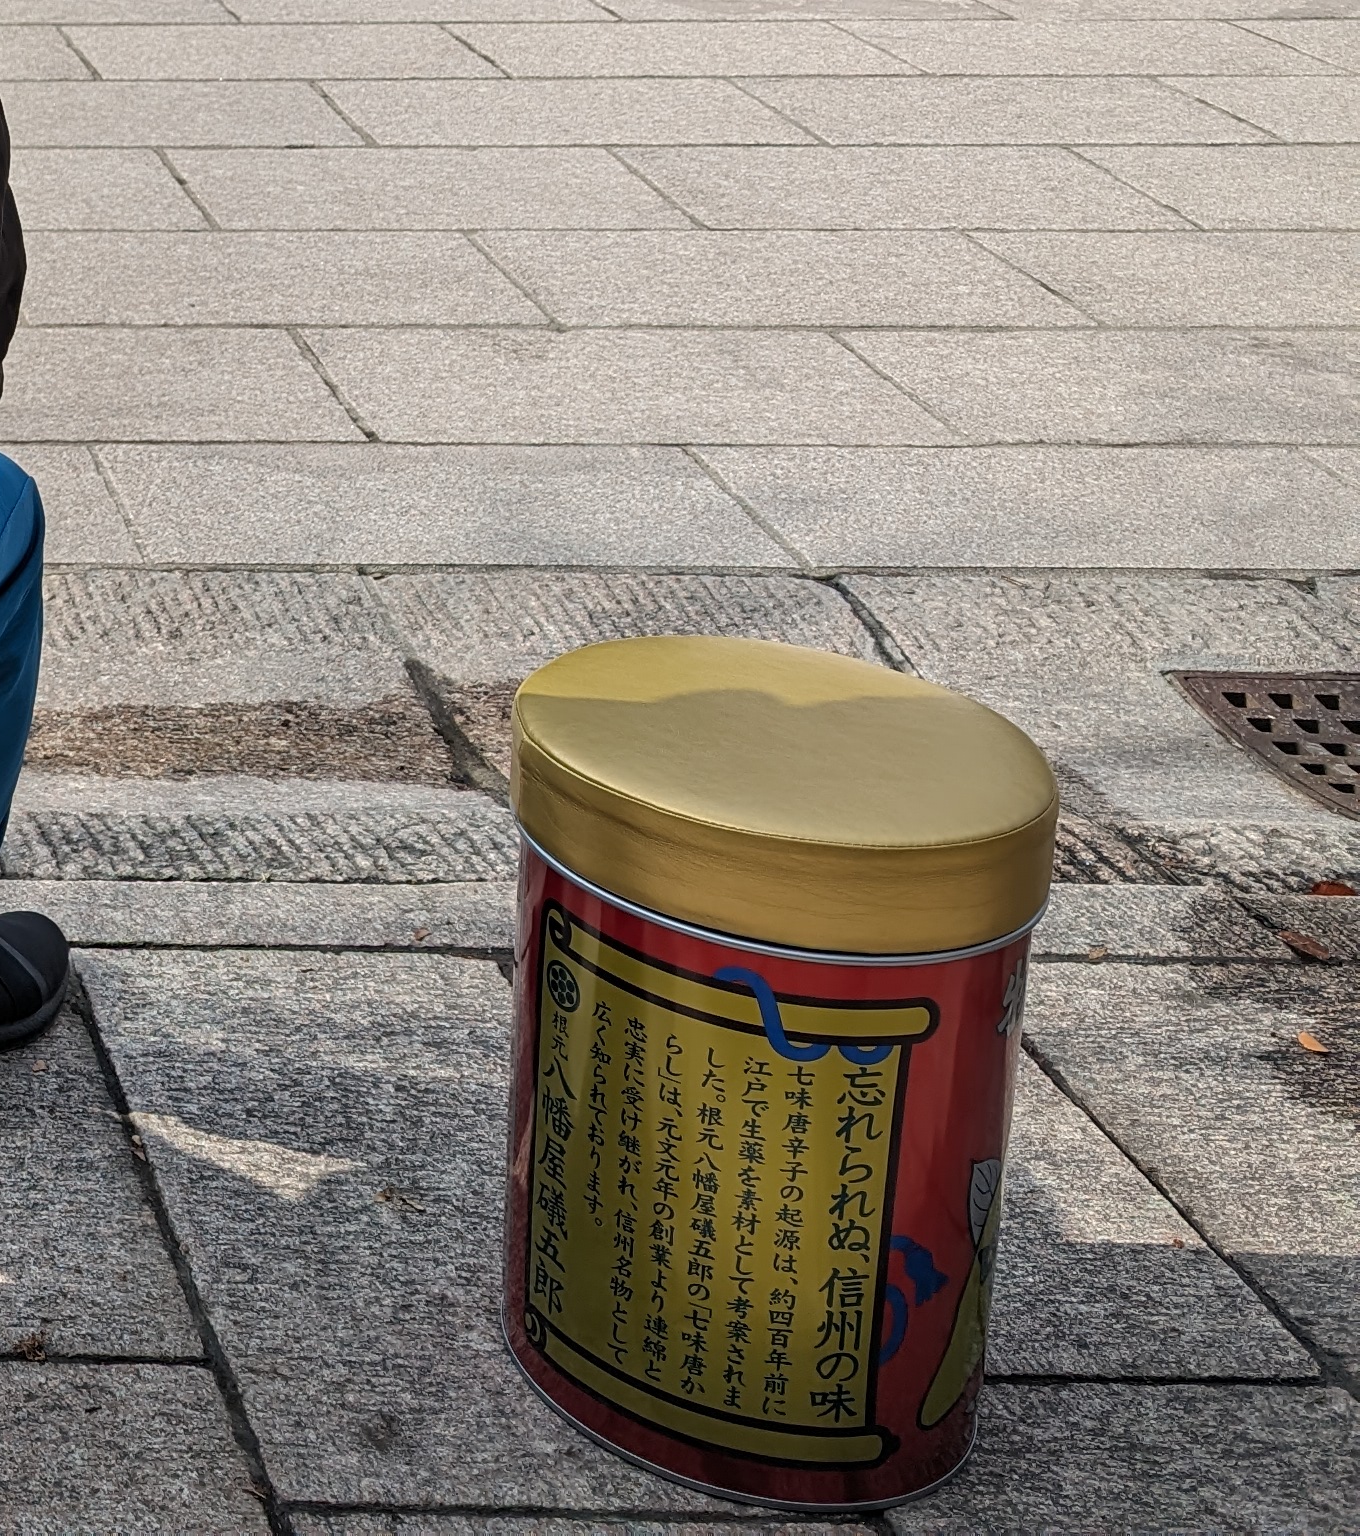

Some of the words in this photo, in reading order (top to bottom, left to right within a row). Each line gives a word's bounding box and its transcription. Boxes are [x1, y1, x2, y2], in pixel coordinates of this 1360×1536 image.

[583, 1000, 612, 1228] 広く知られております。
[607, 1016, 648, 1365] 忠実に受け継がれ、信州名物として
[723, 1056, 773, 1409] 江戸で生薬を素材として考案されま
[762, 1065, 816, 1416] 七味唐辛子の起源は、約四百年前に
[809, 1066, 886, 1424] 忘れられぬ、信州の味
